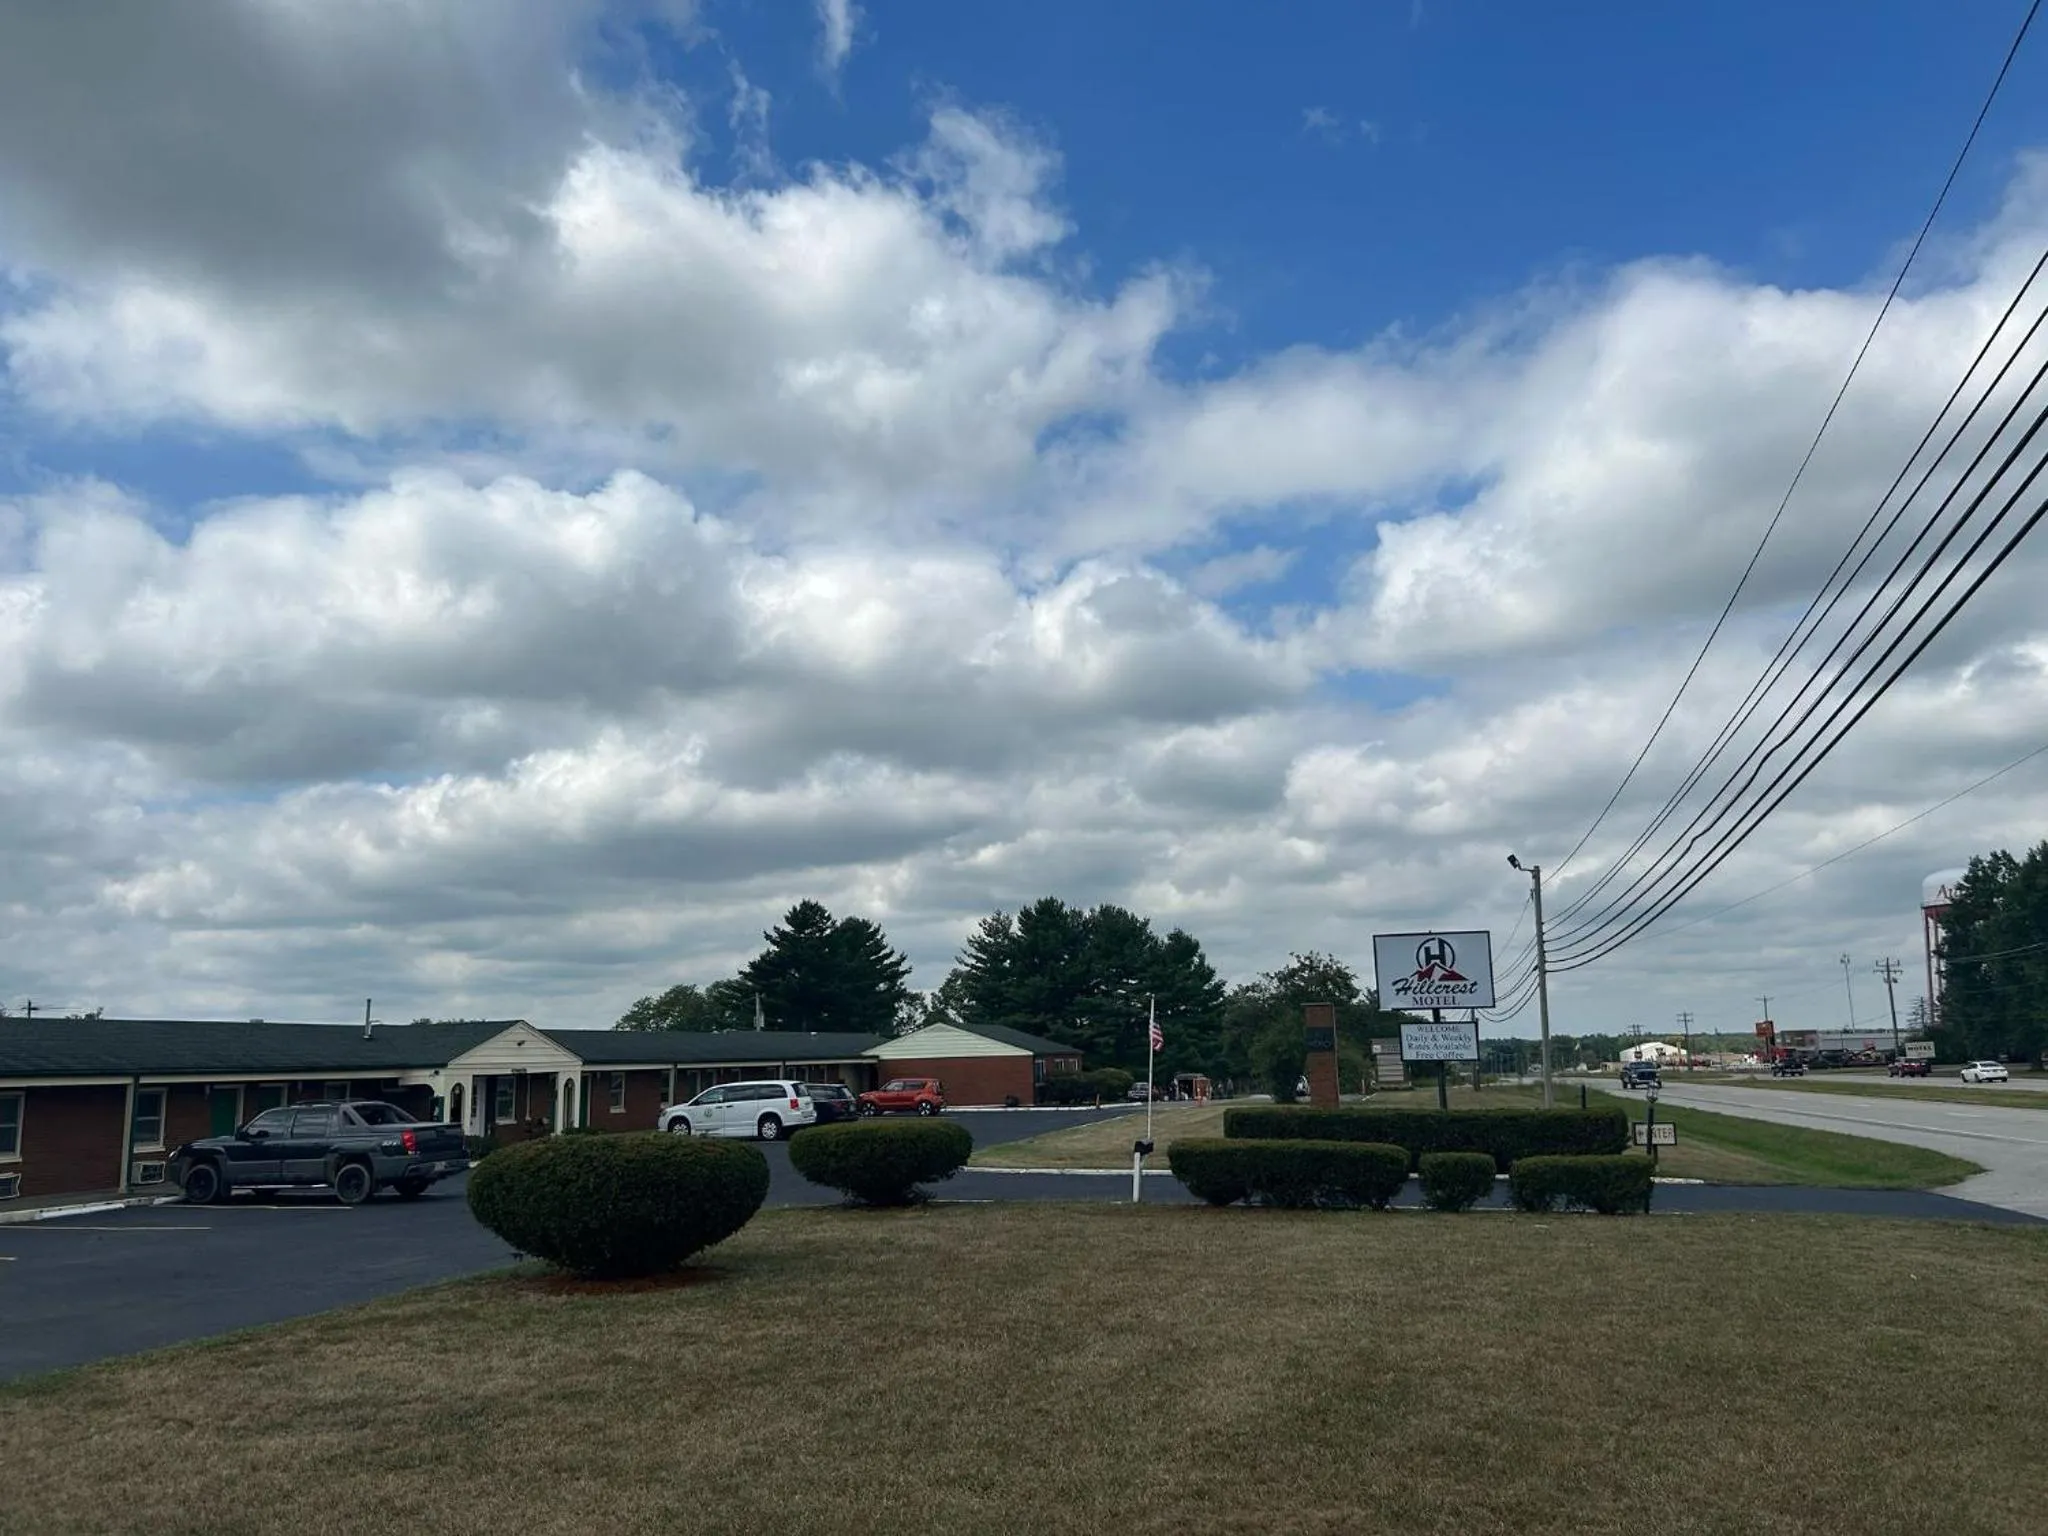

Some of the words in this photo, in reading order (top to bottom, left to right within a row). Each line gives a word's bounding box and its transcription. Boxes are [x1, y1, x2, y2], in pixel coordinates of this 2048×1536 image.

[1392, 978, 1477, 996] Hillcrest
[1412, 996, 1459, 1006] MOTEL
[1416, 1025, 1460, 1033] WELCOME
[1406, 1033, 1428, 1044] Daily
[1430, 1034, 1437, 1042] &
[1441, 1033, 1472, 1044] Weekly
[1432, 1042, 1472, 1051] Available
[1416, 1051, 1434, 1059] Free
[1435, 1051, 1465, 1059] Coffee
